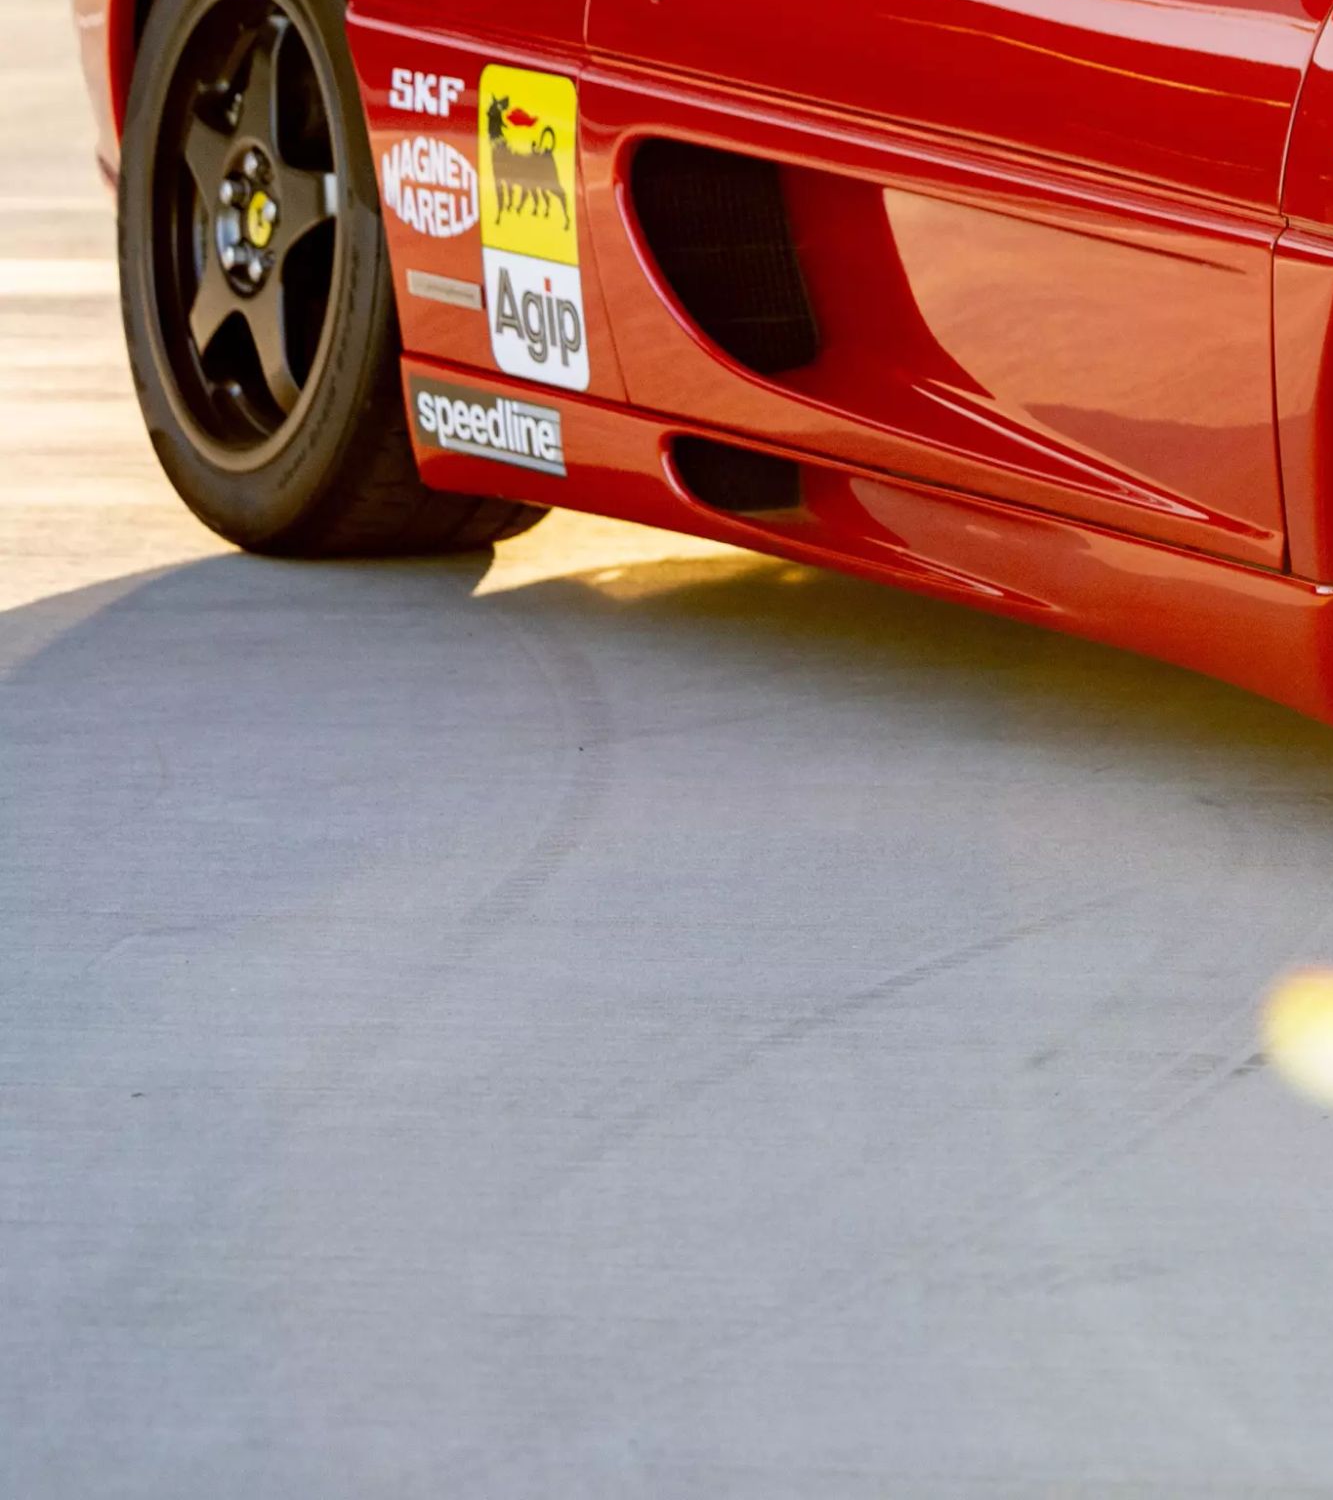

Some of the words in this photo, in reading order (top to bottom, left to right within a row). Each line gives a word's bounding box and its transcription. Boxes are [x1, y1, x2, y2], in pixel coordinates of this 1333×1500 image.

[389, 67, 465, 117] SKF
[382, 136, 478, 202] MAGNETI
[382, 170, 479, 237] MARELLI
[496, 267, 581, 367] Agip
[417, 390, 561, 460] speedline
